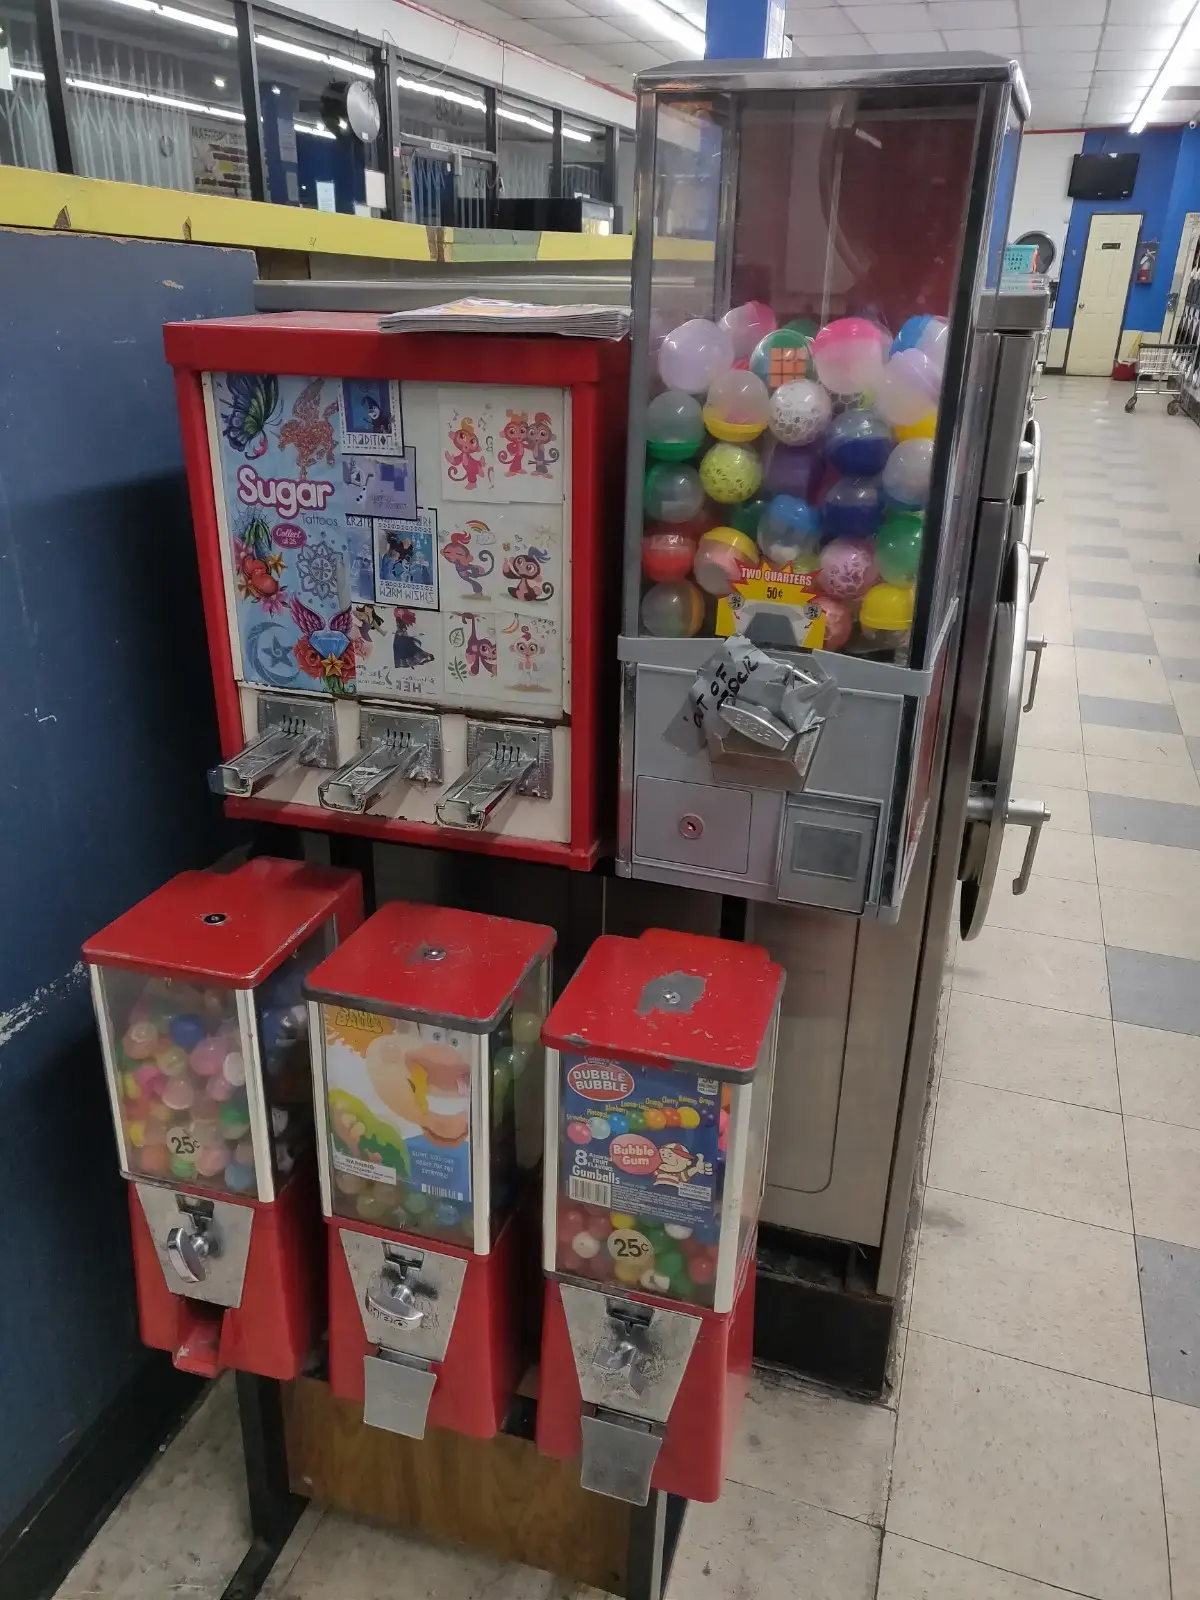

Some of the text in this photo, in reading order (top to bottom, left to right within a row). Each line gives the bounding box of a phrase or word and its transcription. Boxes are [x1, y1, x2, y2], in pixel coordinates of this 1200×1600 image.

[345, 433, 393, 447] TRADITION
[238, 466, 334, 518] Sugar
[300, 512, 338, 527] Tattoos
[275, 527, 302, 540] Collect
[741, 567, 812, 586] TWO QUARTERS
[766, 586, 783, 599] 50¢
[572, 1069, 626, 1082] DUBBLE
[575, 1080, 628, 1093] BUBBLE
[574, 1149, 588, 1166] 8
[613, 1144, 655, 1157] Bubble
[622, 1156, 650, 1165] Gum
[572, 1164, 621, 1185] Gumballs
[613, 1238, 649, 1258] 25¢
